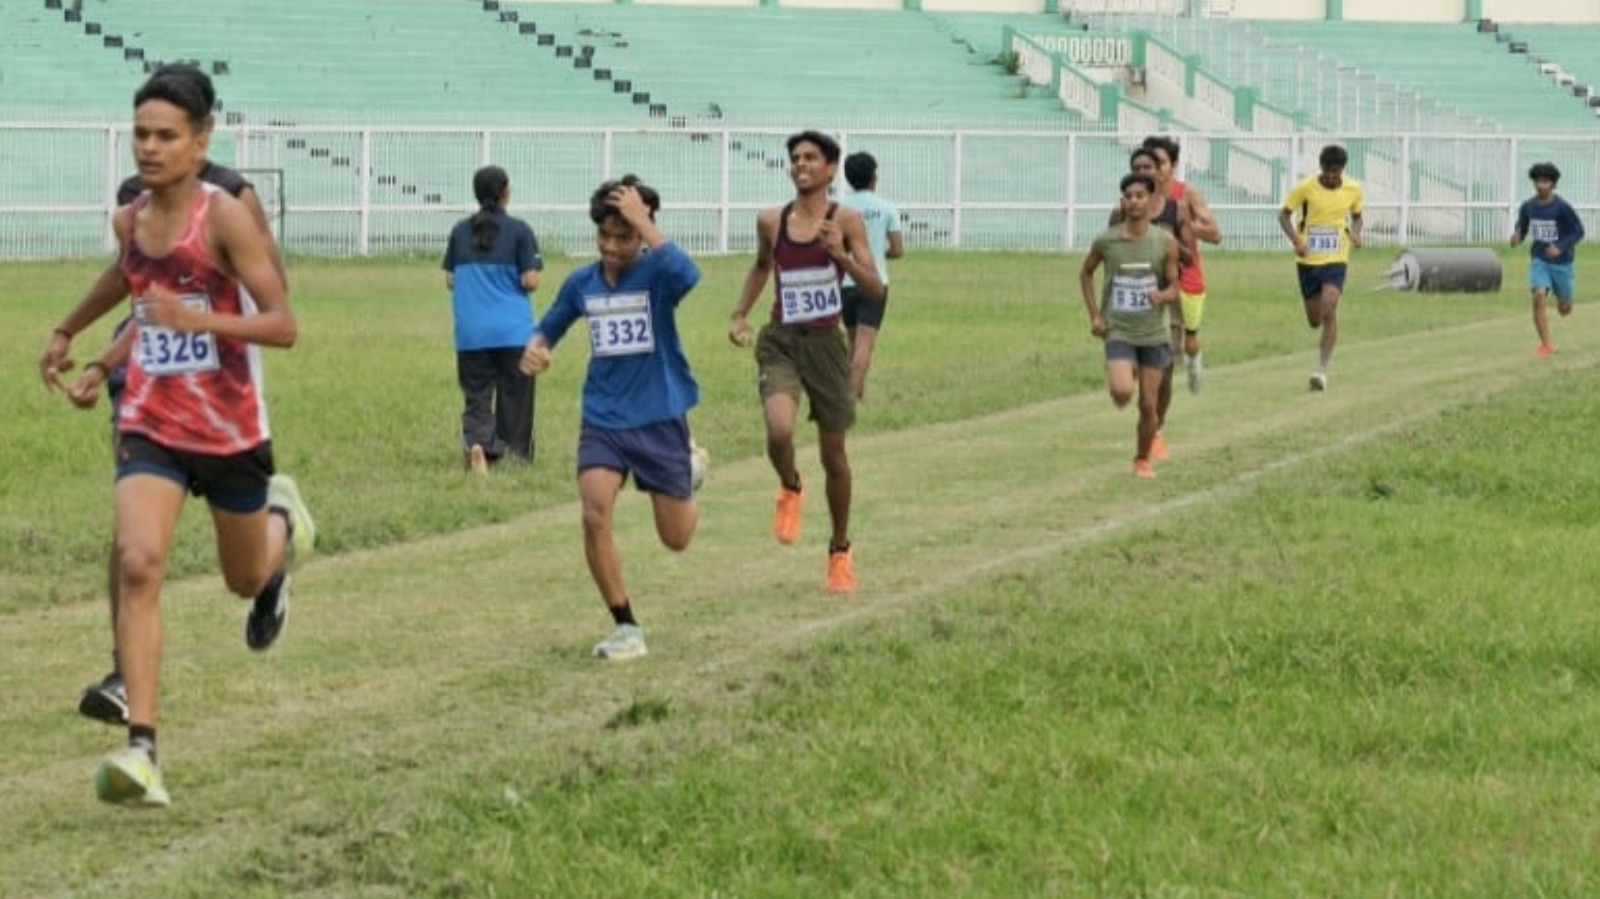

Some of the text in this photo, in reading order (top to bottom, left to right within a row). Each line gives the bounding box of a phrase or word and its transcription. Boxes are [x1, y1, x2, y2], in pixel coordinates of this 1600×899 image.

[801, 288, 837, 313] 304
[607, 318, 648, 345] 332
[157, 330, 208, 364] 326
